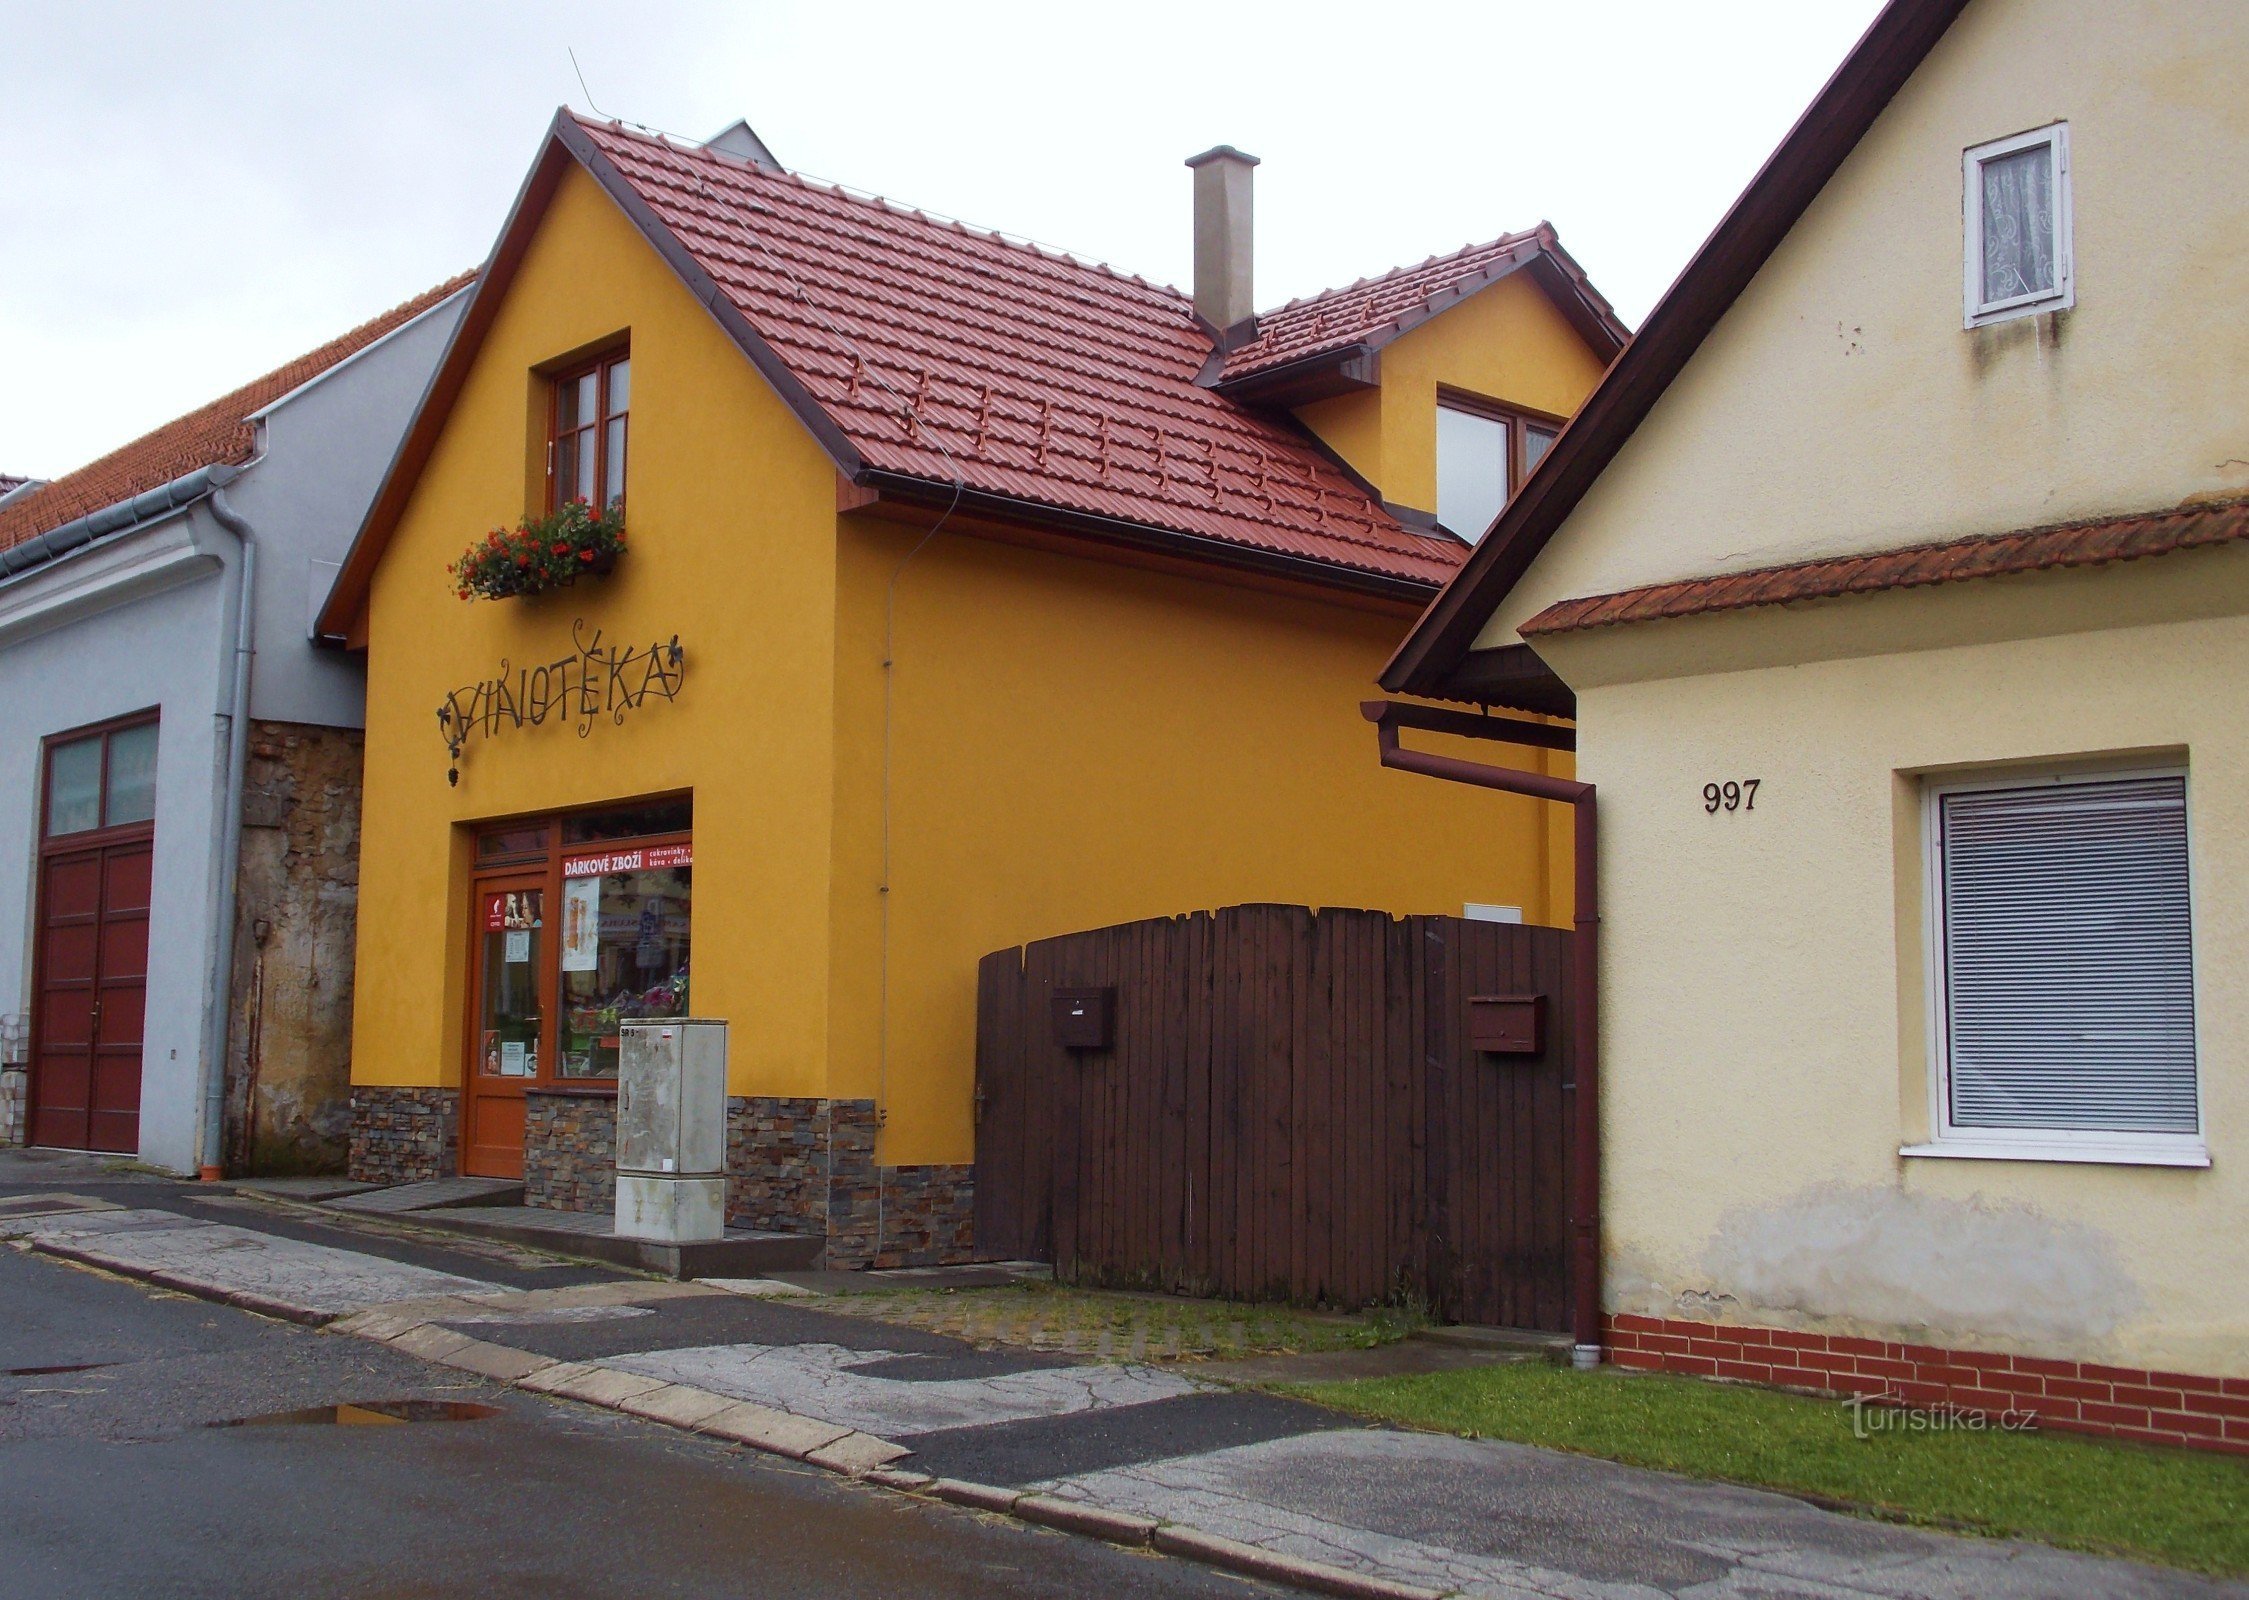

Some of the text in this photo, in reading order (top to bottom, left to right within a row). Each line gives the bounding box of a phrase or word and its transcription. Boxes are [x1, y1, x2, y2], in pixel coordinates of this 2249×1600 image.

[445, 628, 681, 744] VINOTÉKA
[1703, 779, 1761, 813] 997
[564, 851, 642, 876] DÁRKOVÉ ZBOŽÍ
[649, 846, 685, 858] cukrovinky
[649, 858, 666, 867] káva
